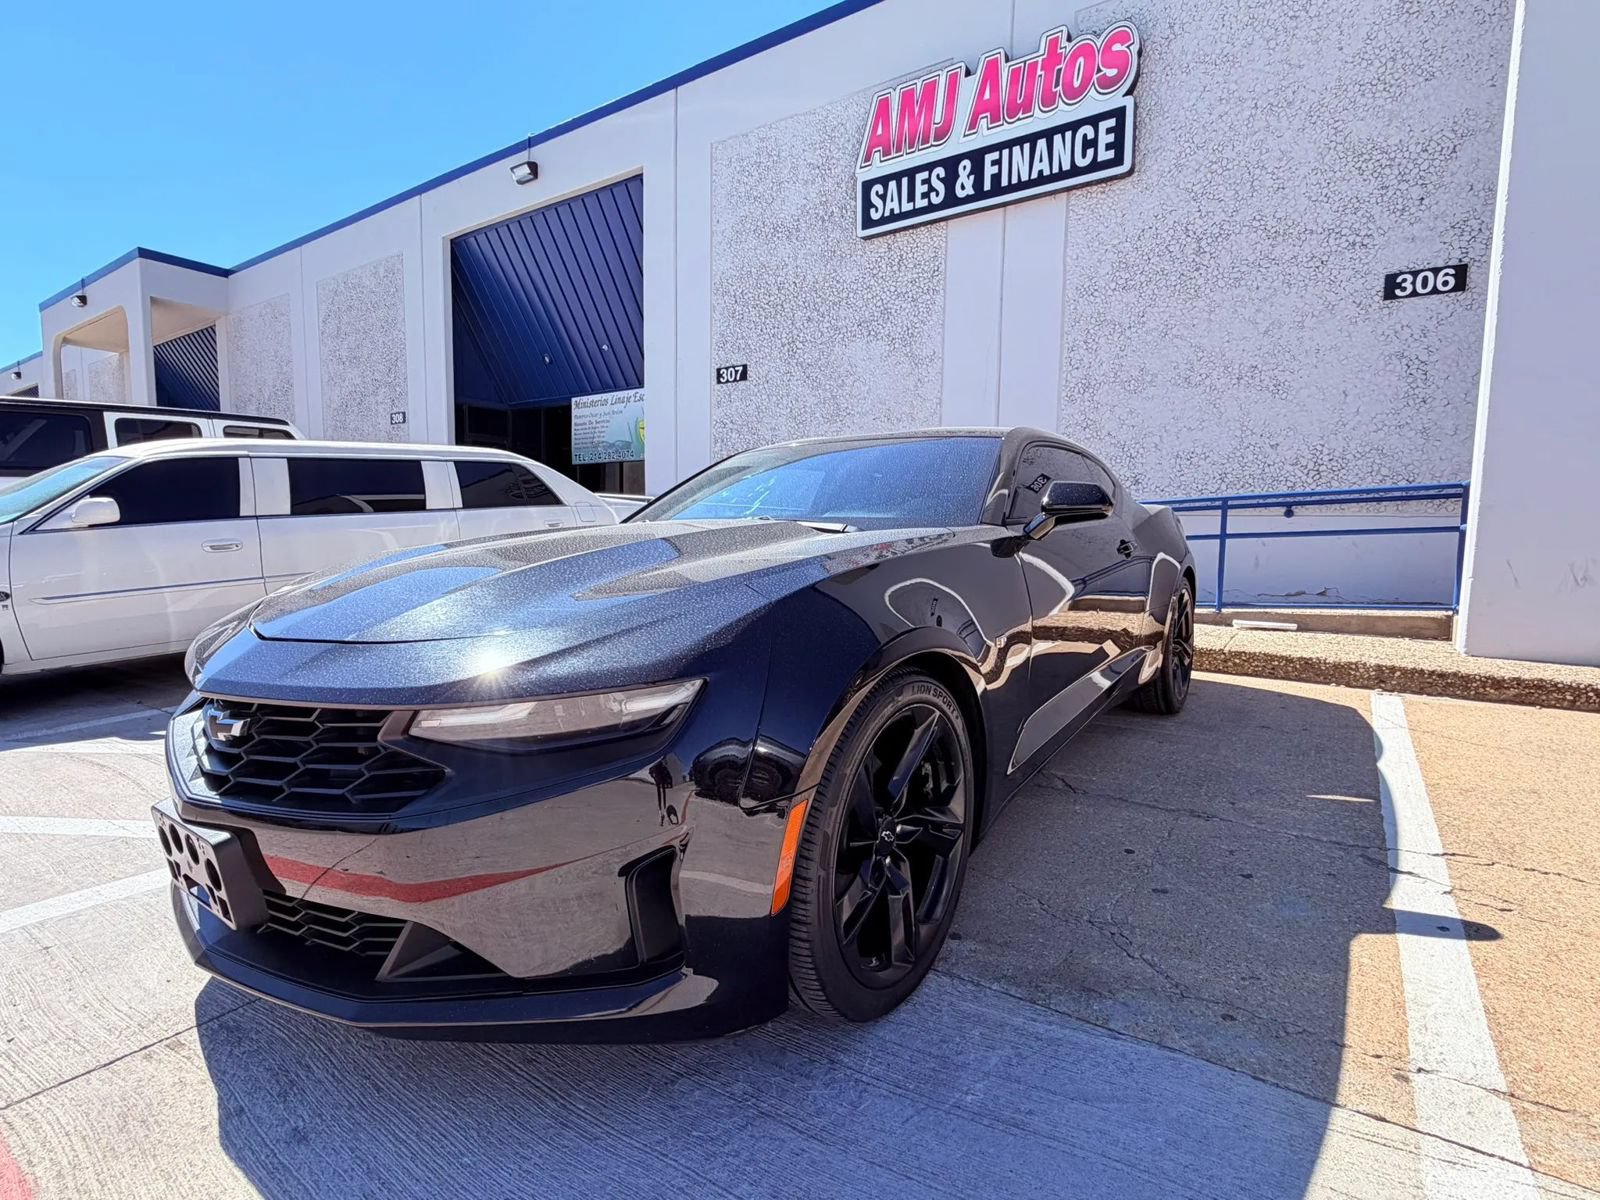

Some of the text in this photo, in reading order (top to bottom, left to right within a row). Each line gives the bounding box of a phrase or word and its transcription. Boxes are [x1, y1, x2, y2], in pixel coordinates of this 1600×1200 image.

[861, 27, 1135, 167] AMJ Autos
[869, 117, 1117, 221] SALES & FINANCE
[1394, 268, 1456, 297] 306
[720, 366, 743, 383] 307
[574, 396, 609, 410] Ministerios
[610, 392, 632, 408] Linaje
[391, 413, 404, 424] 308
[911, 684, 956, 715] LION SPORT
